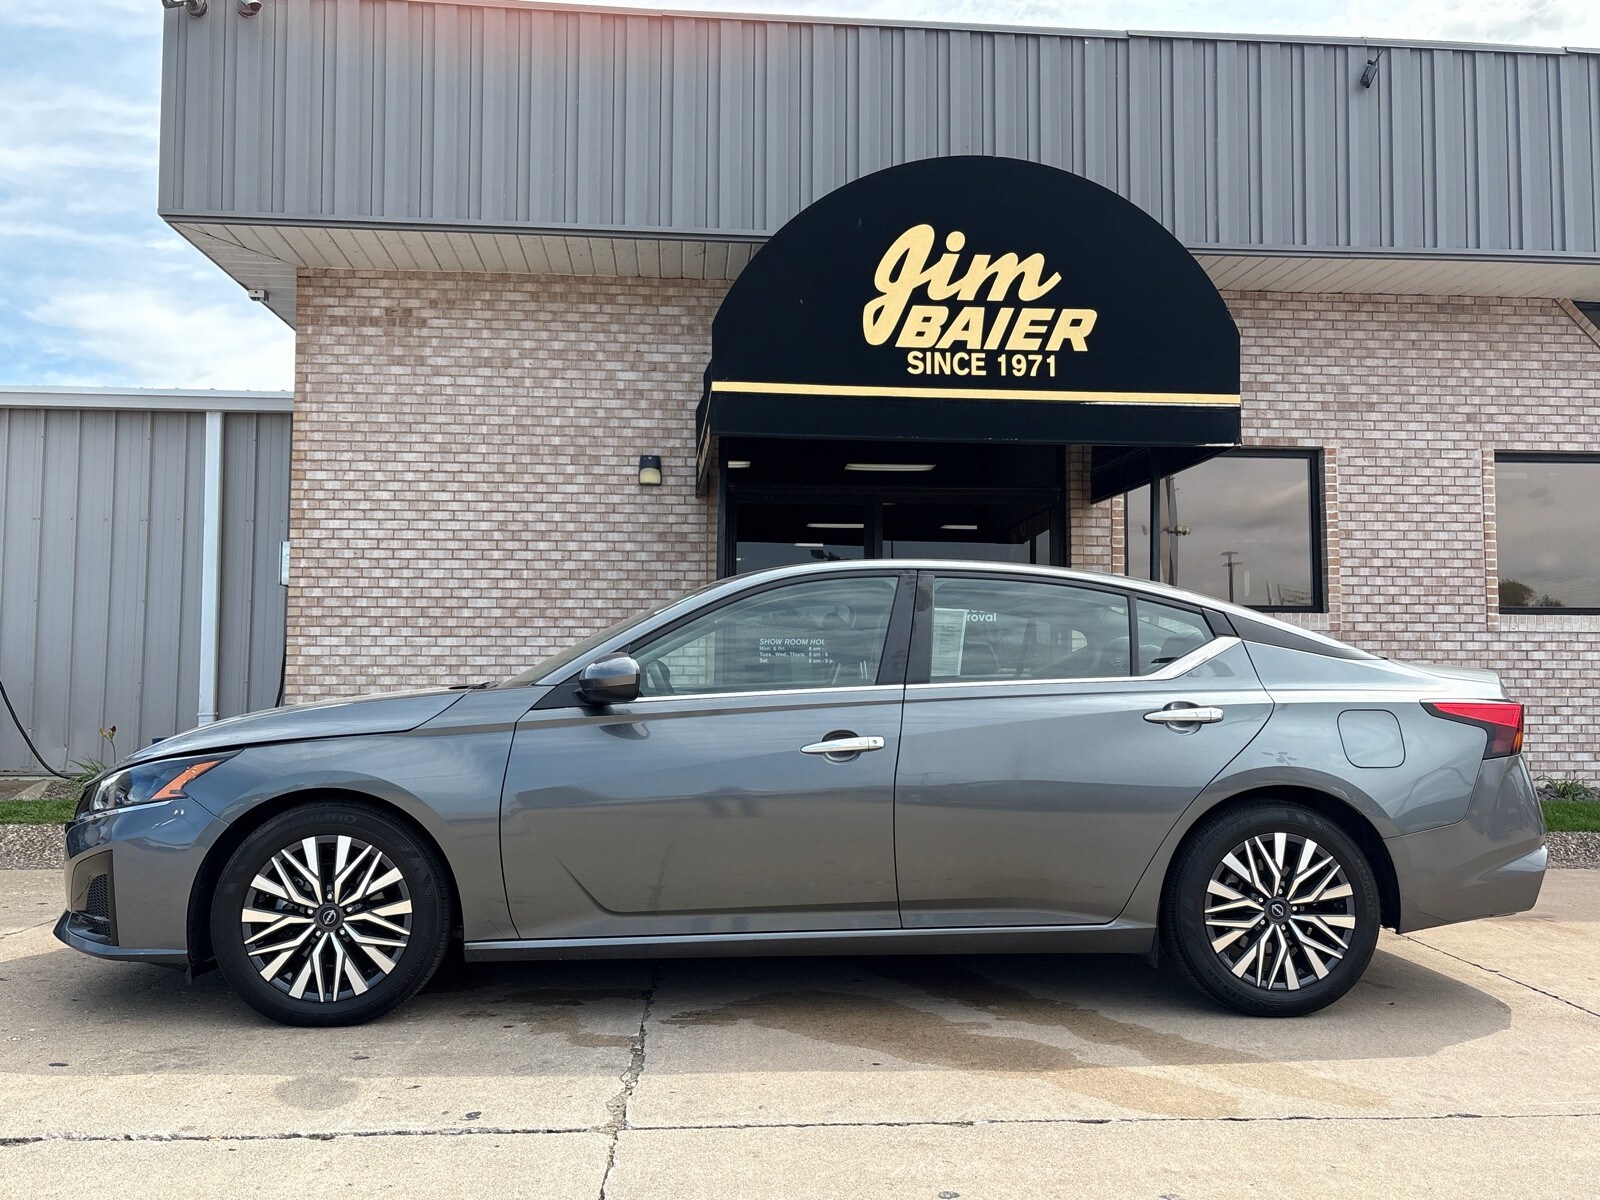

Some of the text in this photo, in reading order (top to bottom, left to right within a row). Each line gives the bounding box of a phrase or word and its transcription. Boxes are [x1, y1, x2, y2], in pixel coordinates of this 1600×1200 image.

[863, 223, 1062, 346] Jim
[895, 304, 1098, 352] BAIER
[906, 351, 1056, 378] SINCE 1971
[759, 638, 782, 646] SHOW
[784, 638, 808, 646] ROOM
